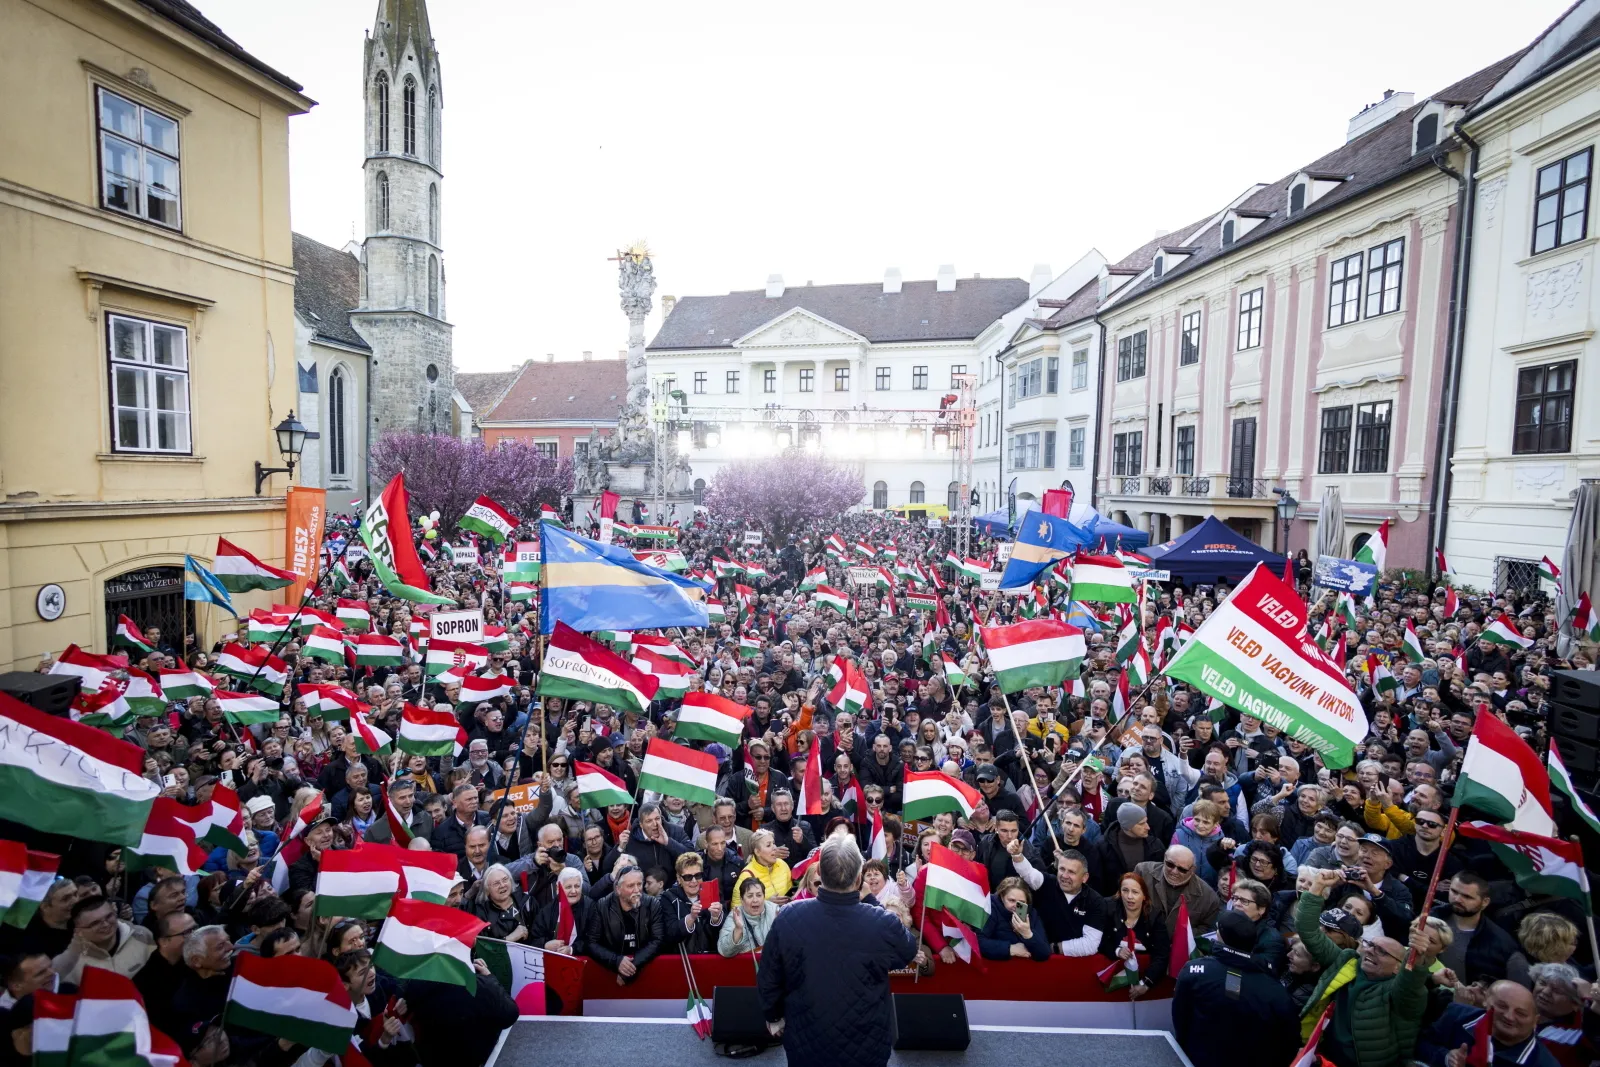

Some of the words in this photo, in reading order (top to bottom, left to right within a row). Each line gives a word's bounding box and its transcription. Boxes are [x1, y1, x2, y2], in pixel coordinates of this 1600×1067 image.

[309, 506, 319, 556] VÁLASZTÁS
[293, 526, 308, 577] FIDESZ
[521, 553, 541, 561] BEL
[126, 572, 161, 582] ANGYAL
[143, 578, 181, 589] MÚZEUM
[1321, 575, 1350, 585] SOPRON
[1255, 593, 1299, 629] VELED
[437, 619, 479, 635] SOPRON
[1226, 626, 1263, 659] VELED
[1261, 653, 1320, 700] VAGYUNK
[1316, 690, 1356, 723] VIKTOR!
[1200, 663, 1237, 698] VELED
[1238, 688, 1296, 733] VAGYUNK
[1293, 723, 1340, 755] VIKTOR!
[1190, 965, 1204, 973] HH
